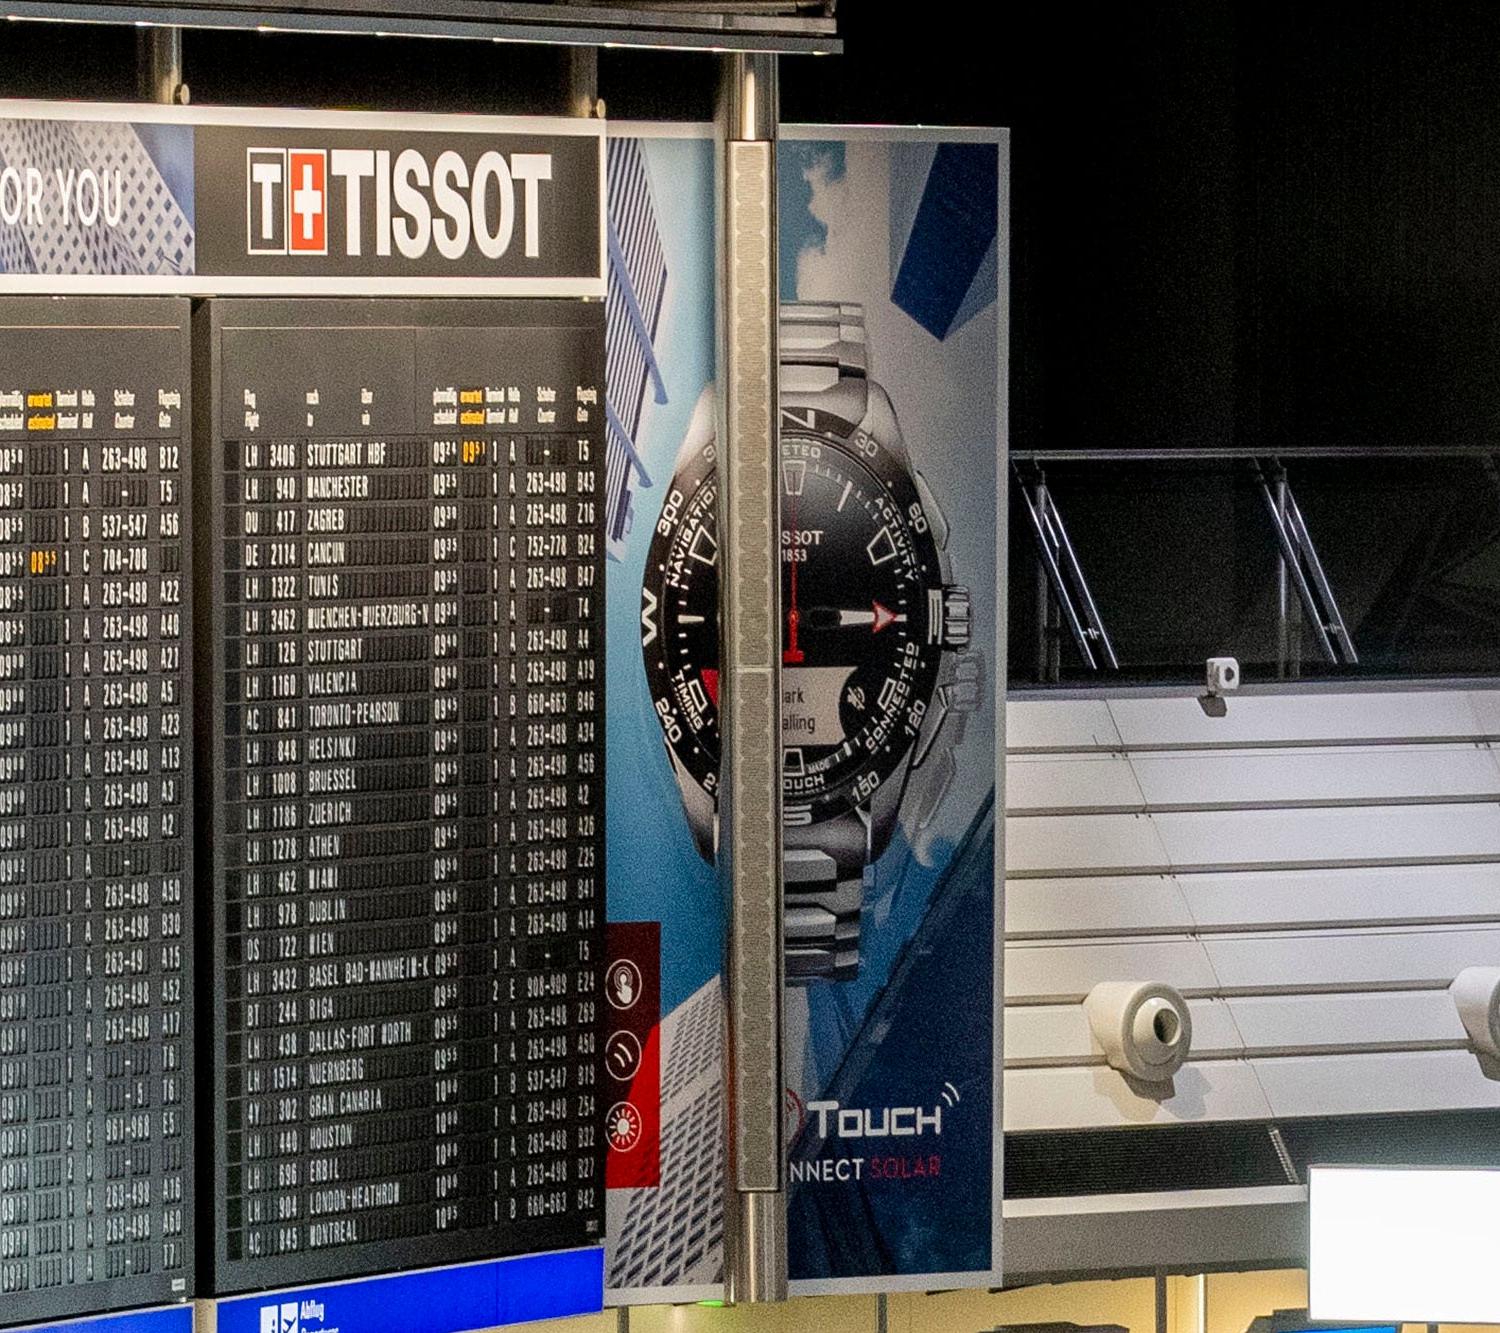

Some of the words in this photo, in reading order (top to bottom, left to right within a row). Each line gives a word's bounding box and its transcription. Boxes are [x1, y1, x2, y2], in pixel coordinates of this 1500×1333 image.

[53, 166, 123, 229] YOU
[330, 149, 553, 260] TISSOT
[245, 477, 259, 501] LH
[275, 477, 296, 500] 940
[306, 475, 369, 499] MANCHESTER
[508, 471, 517, 494] A
[526, 471, 568, 494] 263-498
[656, 488, 683, 537] 300
[781, 548, 808, 562] 1853
[869, 1155, 942, 1179] SOLAR
[299, 1299, 324, 1321] Abflug
